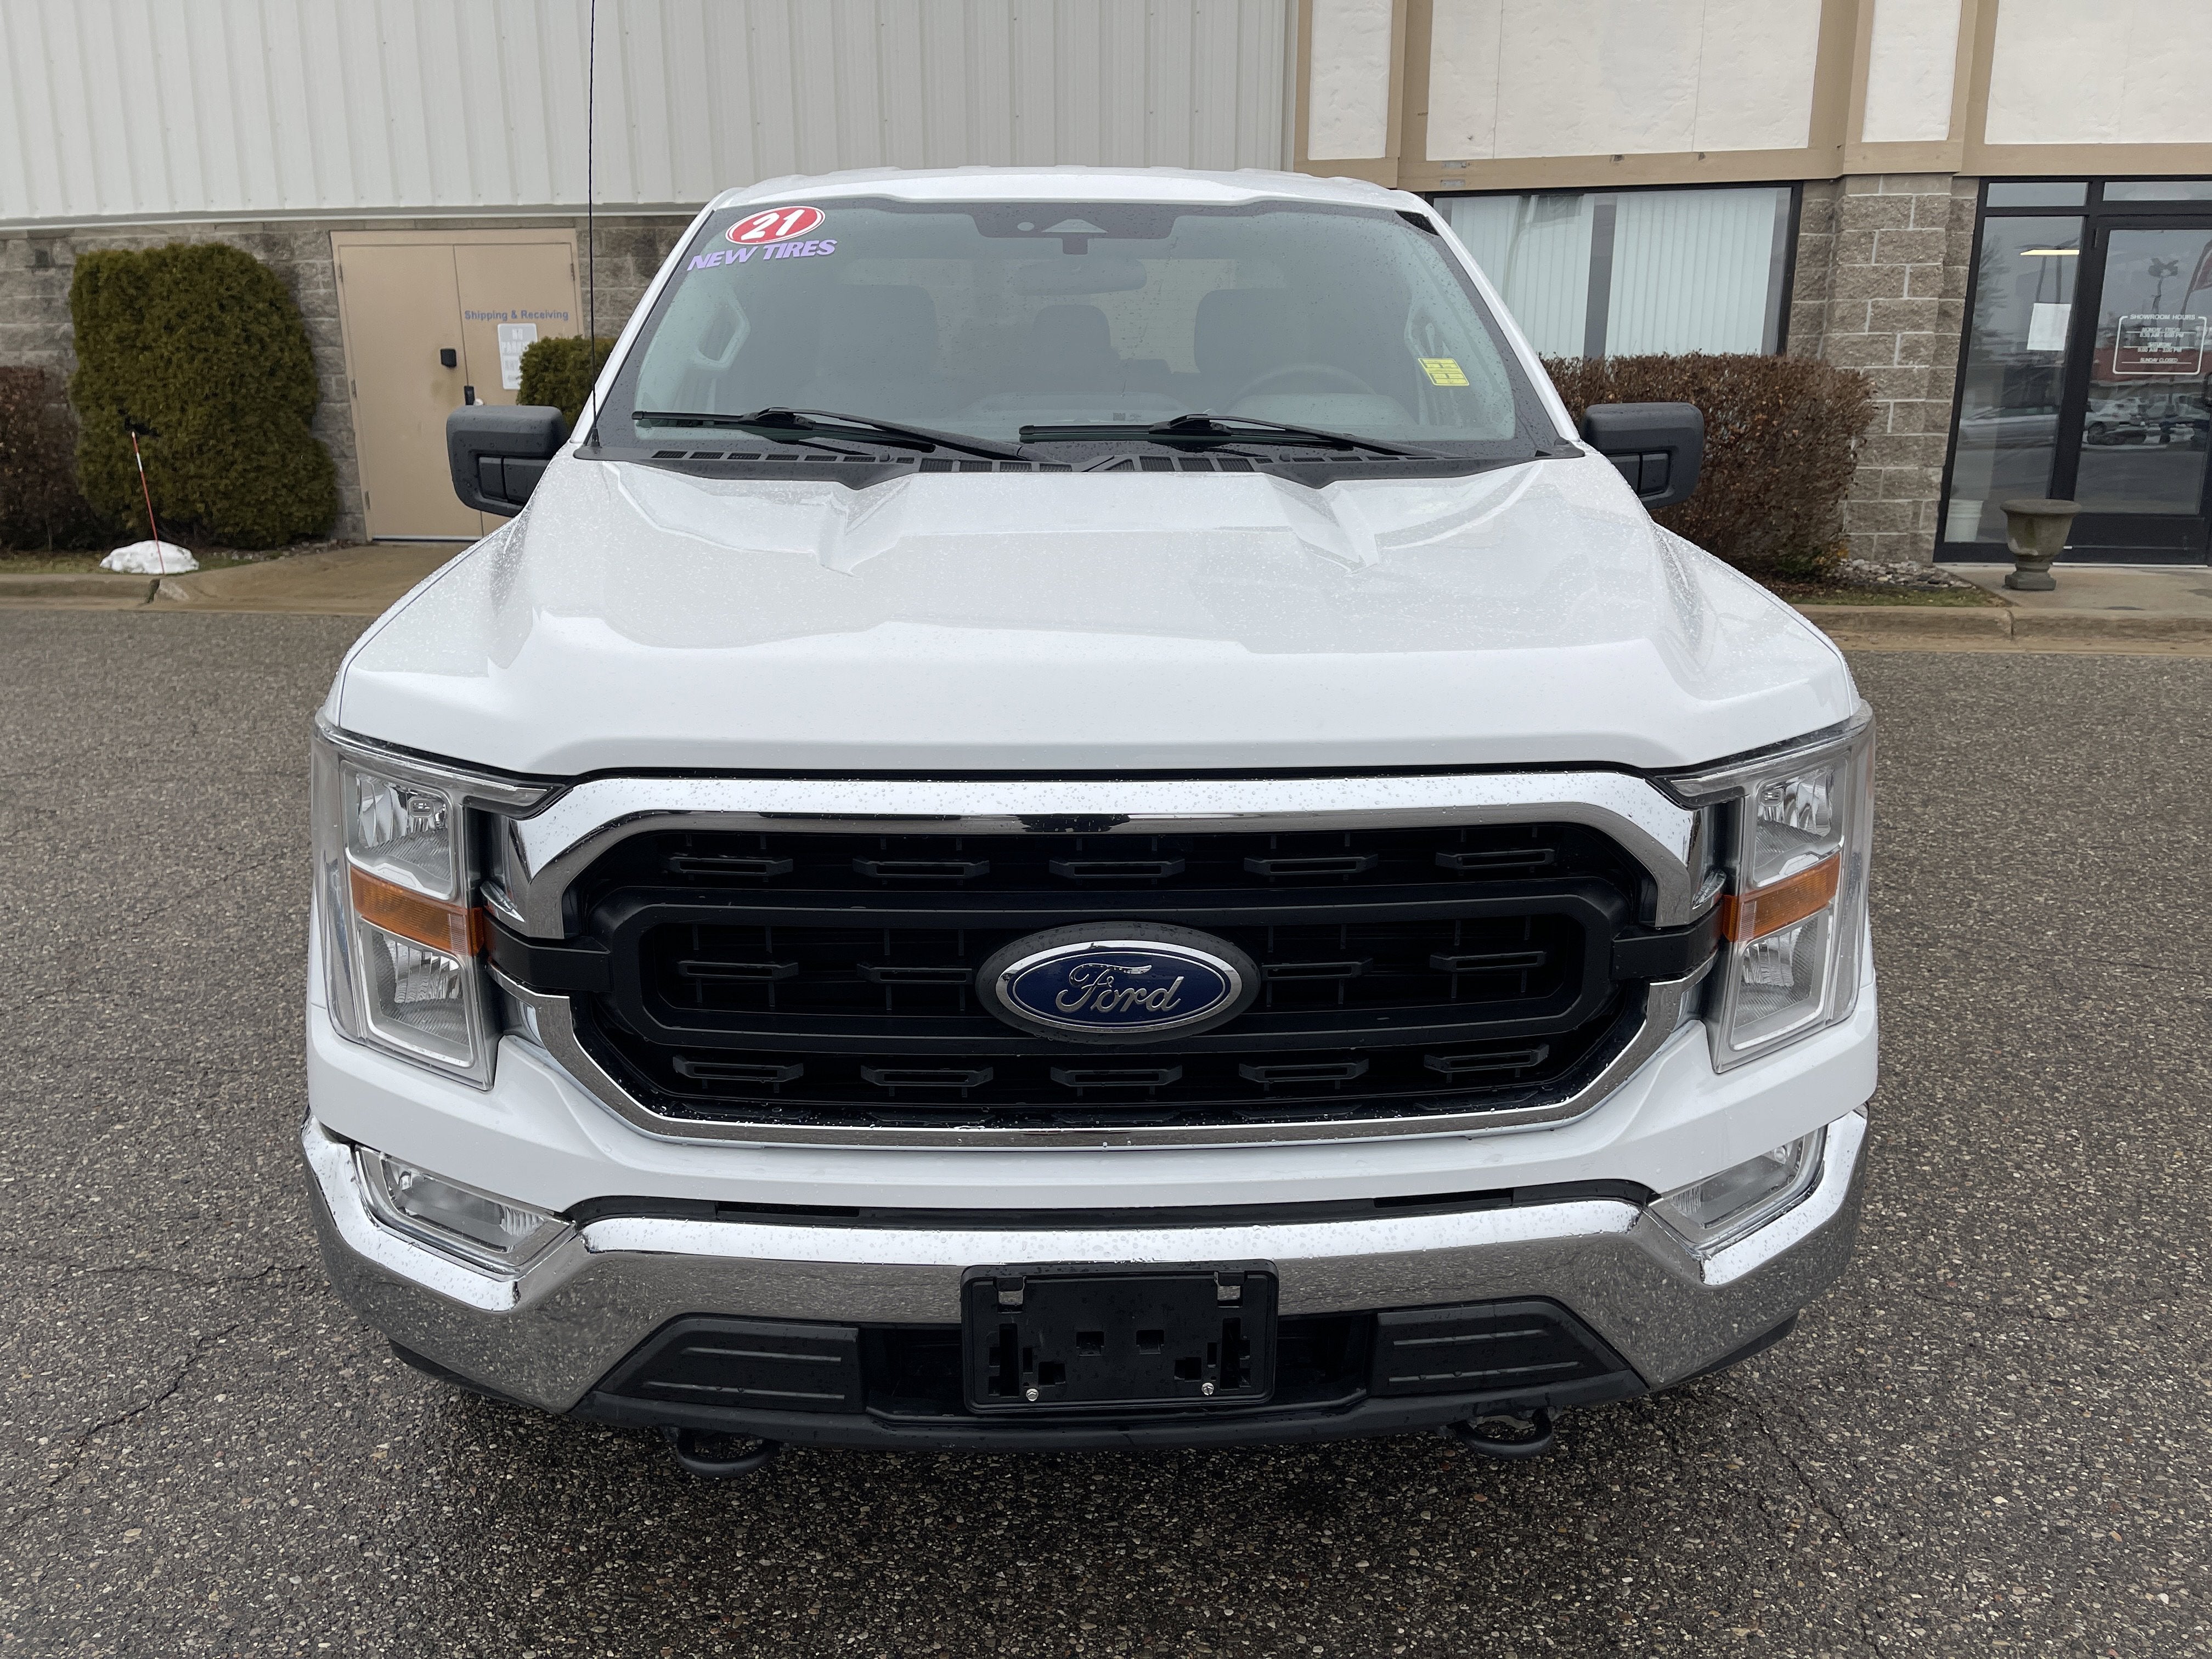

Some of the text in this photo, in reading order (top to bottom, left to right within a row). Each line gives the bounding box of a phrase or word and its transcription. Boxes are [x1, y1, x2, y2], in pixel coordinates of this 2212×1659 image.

[741, 208, 805, 241] 21
[686, 239, 838, 272] NEW TIRES
[465, 309, 569, 321] Shipping & Receiving
[1055, 962, 1184, 1013] Ford
